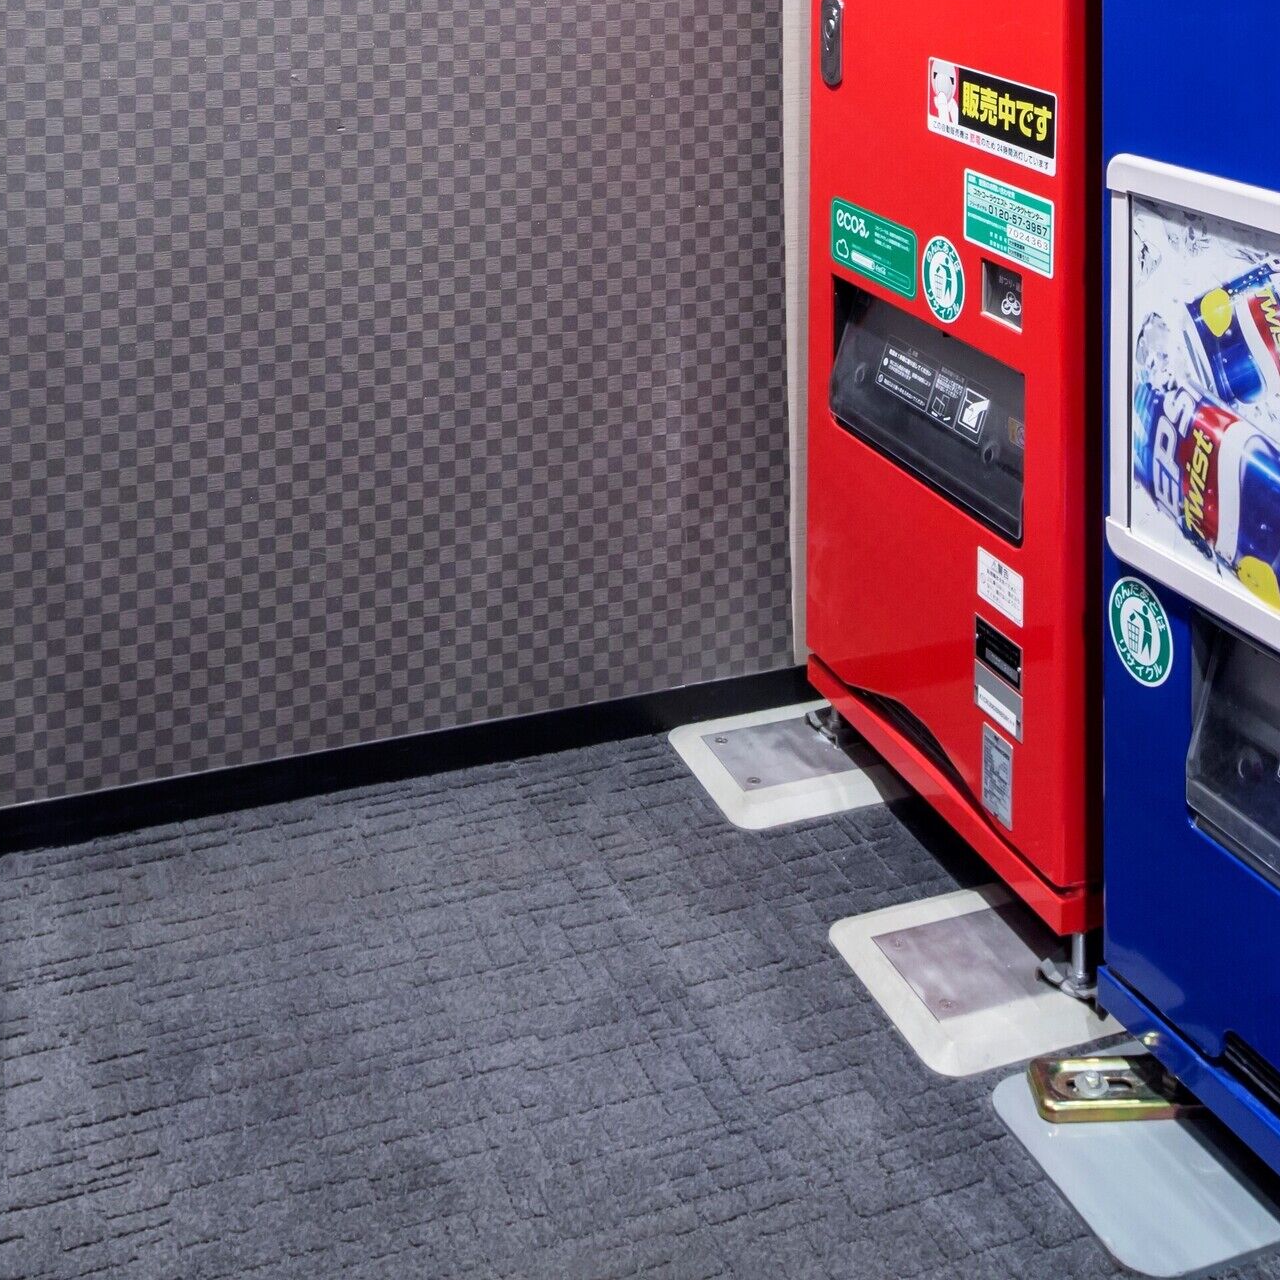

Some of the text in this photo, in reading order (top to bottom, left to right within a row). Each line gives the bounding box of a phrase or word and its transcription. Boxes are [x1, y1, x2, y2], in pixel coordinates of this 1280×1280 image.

[961, 80, 1053, 142] 販売中です
[1114, 582, 1167, 632] のんだあとは
[1118, 638, 1163, 681] リサイクル
